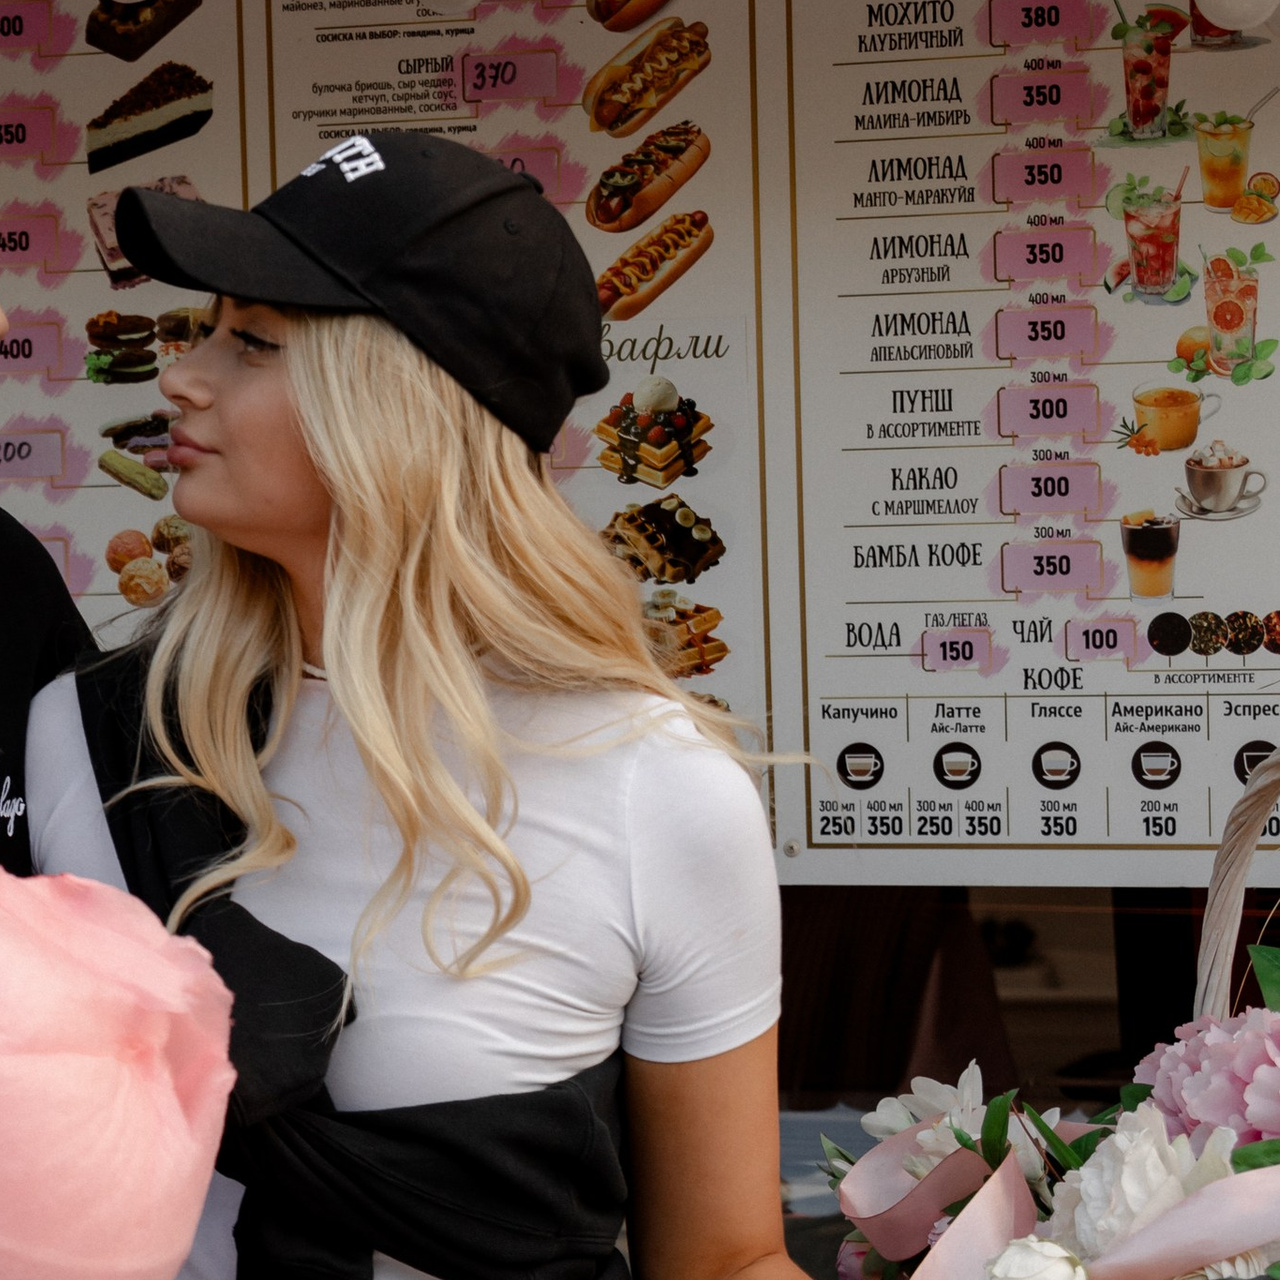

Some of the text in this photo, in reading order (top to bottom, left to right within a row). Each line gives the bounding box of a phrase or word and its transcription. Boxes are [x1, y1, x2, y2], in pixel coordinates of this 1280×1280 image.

[282, 0, 326, 12] майонез,
[867, 0, 954, 27] МОХИТО
[1021, 6, 1060, 28] 380
[316, 26, 475, 43] СОСИСКА НА ВЫБОР: говядина, курица
[858, 27, 964, 52] КЛУБНИЧНЫЙ
[398, 55, 453, 74] СЫРНЫЙ
[1024, 59, 1062, 70] 400 мл
[473, 61, 517, 90] 370
[312, 77, 456, 94] булочка бриошь, сыр чеддер,
[862, 77, 962, 105] ЛИМОНАД
[352, 89, 456, 104] кетчуп, сырный соус,
[1023, 85, 1061, 106] 350
[292, 101, 457, 120] огурчики маринованные, сосиска
[854, 109, 970, 130] МАЛИНА-ИМБИРЬ
[447, 124, 477, 134] курица
[1025, 136, 1063, 150] 400 мл
[867, 155, 968, 183] ЛИМОНАД
[1024, 164, 1062, 185] 350
[854, 187, 975, 208] МАНГО-МАРАКУЙЯ
[1027, 215, 1064, 226] 400 мл
[870, 233, 969, 260] ЛИМОНАД
[1026, 243, 1063, 264] 350
[882, 266, 950, 284] АРБУЗНЫЙ
[1028, 293, 1066, 304] 400 мл
[871, 311, 971, 337] ЛИМОНАД
[1028, 320, 1066, 341] 350
[870, 342, 973, 362] АПЕЛЬСИНОВЫЙ
[1030, 372, 1068, 383] 300 мл
[892, 389, 953, 413] ПУНШ
[1029, 399, 1068, 419] 300
[867, 421, 981, 439] В АССОРТИМЕНТЕ
[1032, 450, 1069, 461] 300 мл
[891, 467, 957, 491] КАКАО
[1031, 477, 1069, 497] 300
[872, 498, 979, 516] С МАРШМЕЛЛОУ
[1034, 527, 1071, 538] 300 мл
[853, 543, 982, 568] БАМБЛ КОФЕ
[1033, 555, 1071, 575] 350
[845, 622, 901, 651] ВОДА
[1013, 617, 1053, 643] ЧАЙ
[1082, 629, 1117, 649] 100
[940, 641, 973, 661] 150
[1023, 667, 1084, 691] КОФЕ
[1154, 673, 1255, 684] В АССОРТИМЕНТЕ
[822, 705, 898, 722] Капучино
[935, 704, 981, 718] Латте
[1031, 703, 1082, 717] Гляссе
[1112, 702, 1203, 720] Американо
[931, 722, 985, 734] Айс-Латте
[1115, 722, 1201, 734] Айс-Американо
[819, 801, 855, 812] 300 мл
[867, 801, 903, 812] 400 мл
[917, 801, 952, 812] 300 мл
[965, 801, 1001, 812] 400 мл
[1040, 801, 1077, 812] 300 мл
[1140, 801, 1178, 812] 200 мл
[820, 816, 855, 836] 250
[868, 816, 903, 836] 350
[917, 816, 952, 836] 250
[965, 816, 1001, 836] 350
[1041, 817, 1077, 836] 350
[1143, 817, 1176, 836] 150
